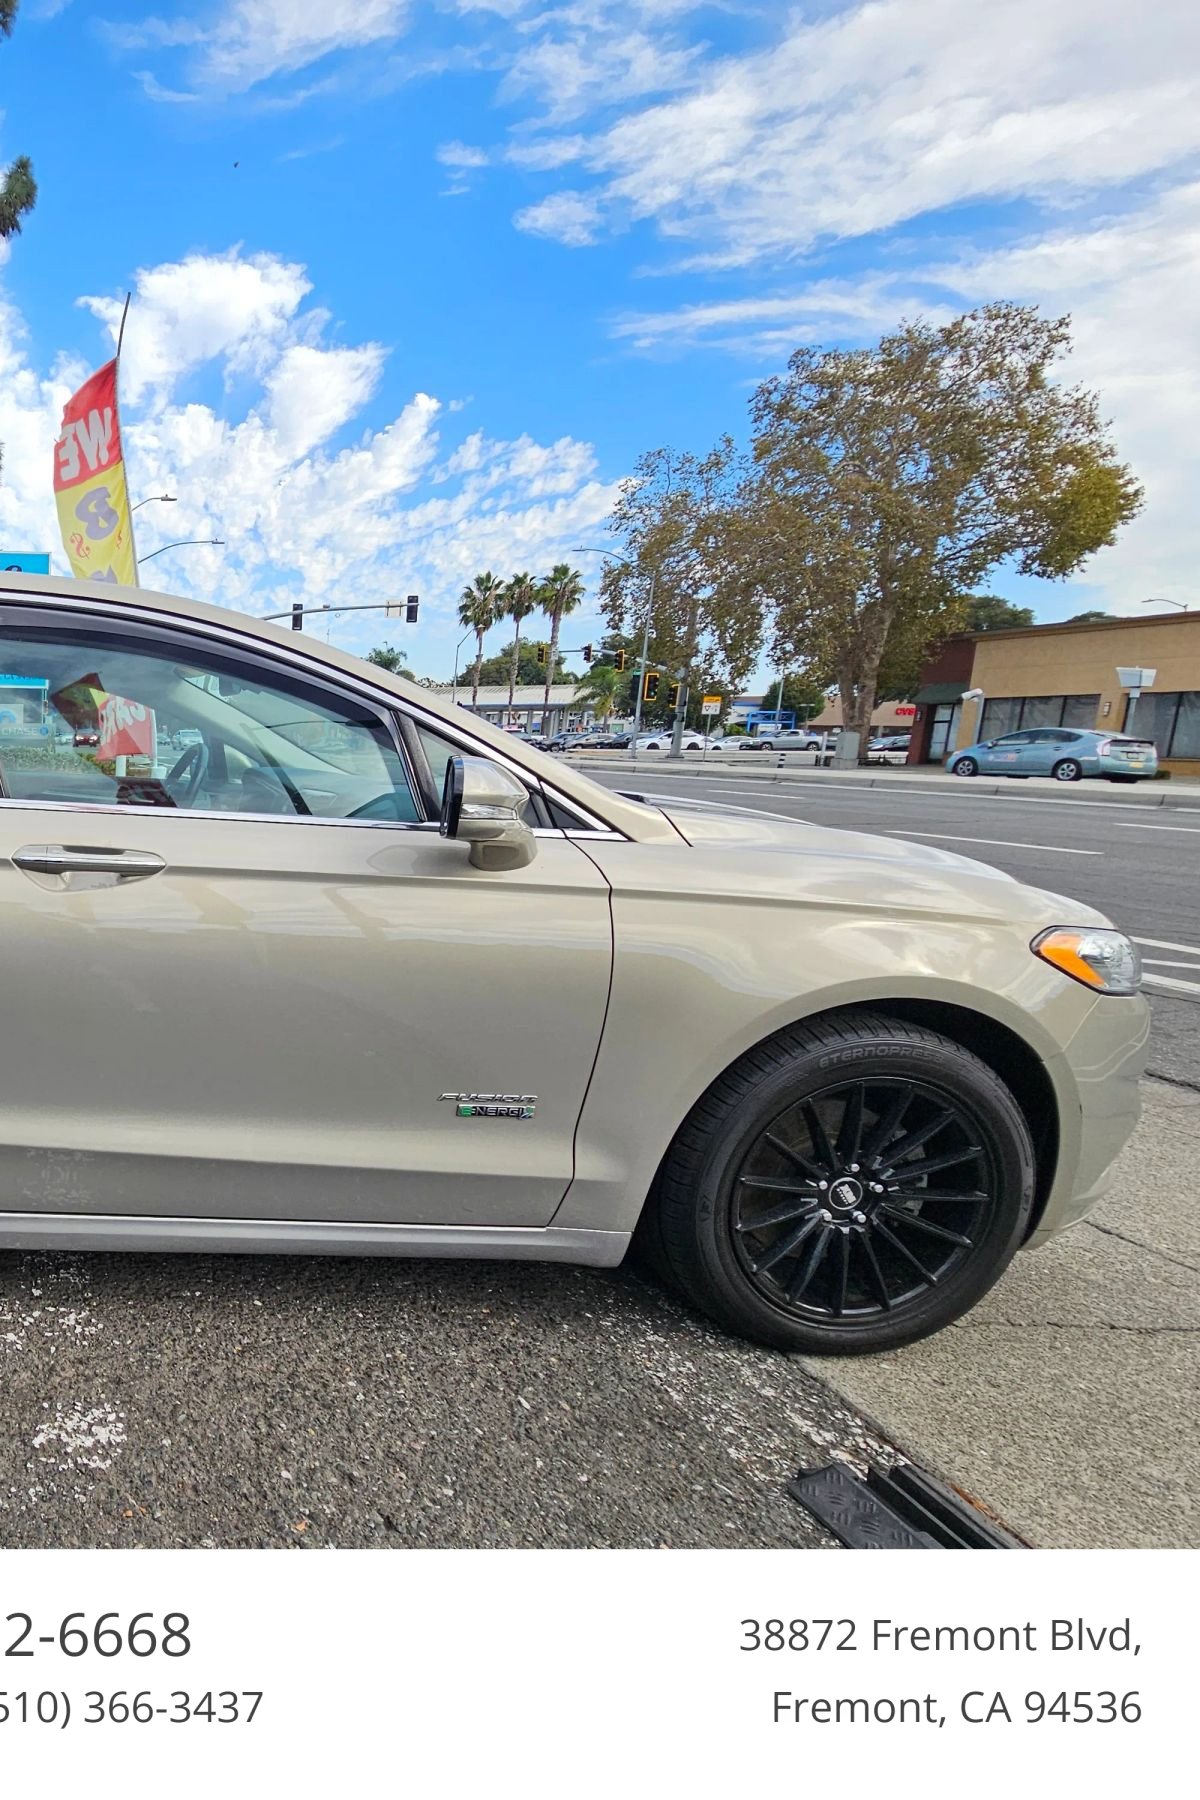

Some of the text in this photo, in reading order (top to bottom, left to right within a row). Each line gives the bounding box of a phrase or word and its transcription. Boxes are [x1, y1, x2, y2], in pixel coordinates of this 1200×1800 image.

[895, 707, 915, 716] CVS
[1, 727, 38, 736] CHASE
[437, 1093, 538, 1103] FUSION
[458, 1105, 526, 1118] ENERGI
